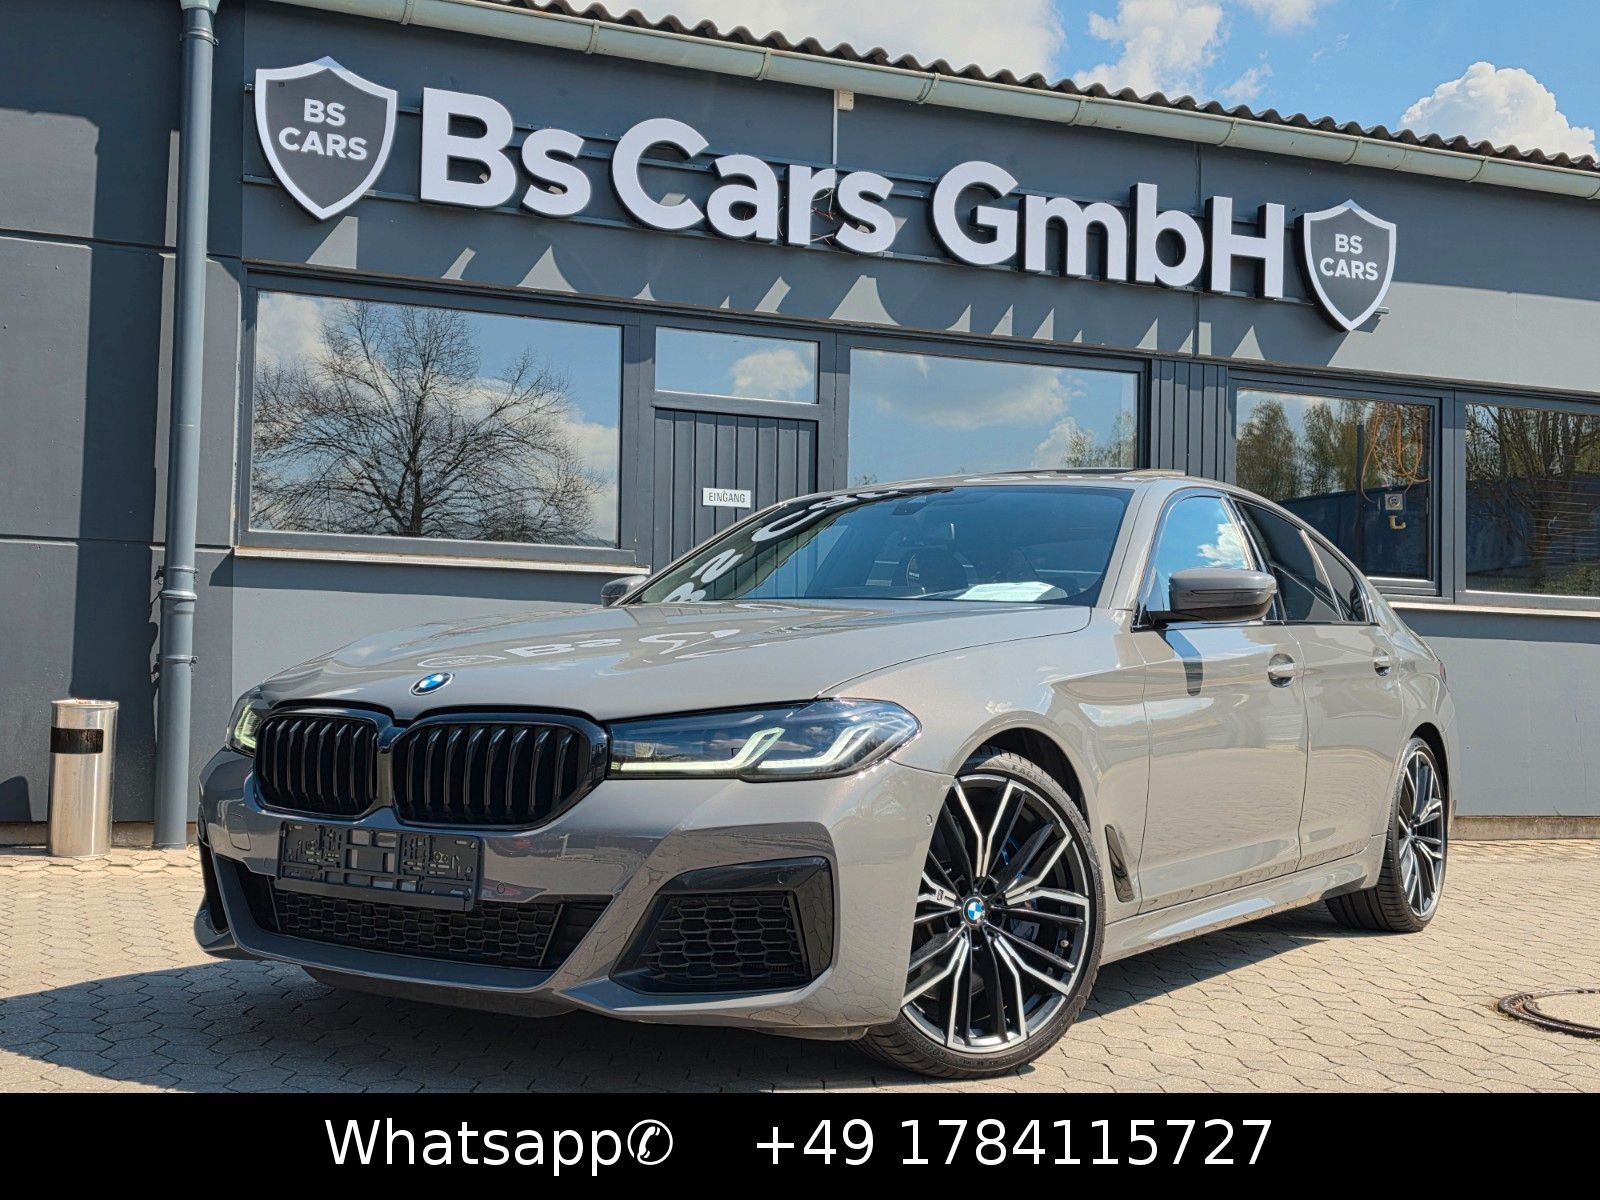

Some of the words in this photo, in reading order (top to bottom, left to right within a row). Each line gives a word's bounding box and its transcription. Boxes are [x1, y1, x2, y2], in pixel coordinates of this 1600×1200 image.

[303, 98, 346, 127] BS
[278, 126, 368, 161] CARS
[932, 161, 1285, 299] GmbH
[1334, 233, 1364, 256] BS
[1319, 257, 1379, 281] CARS
[708, 491, 746, 503] EINGANG
